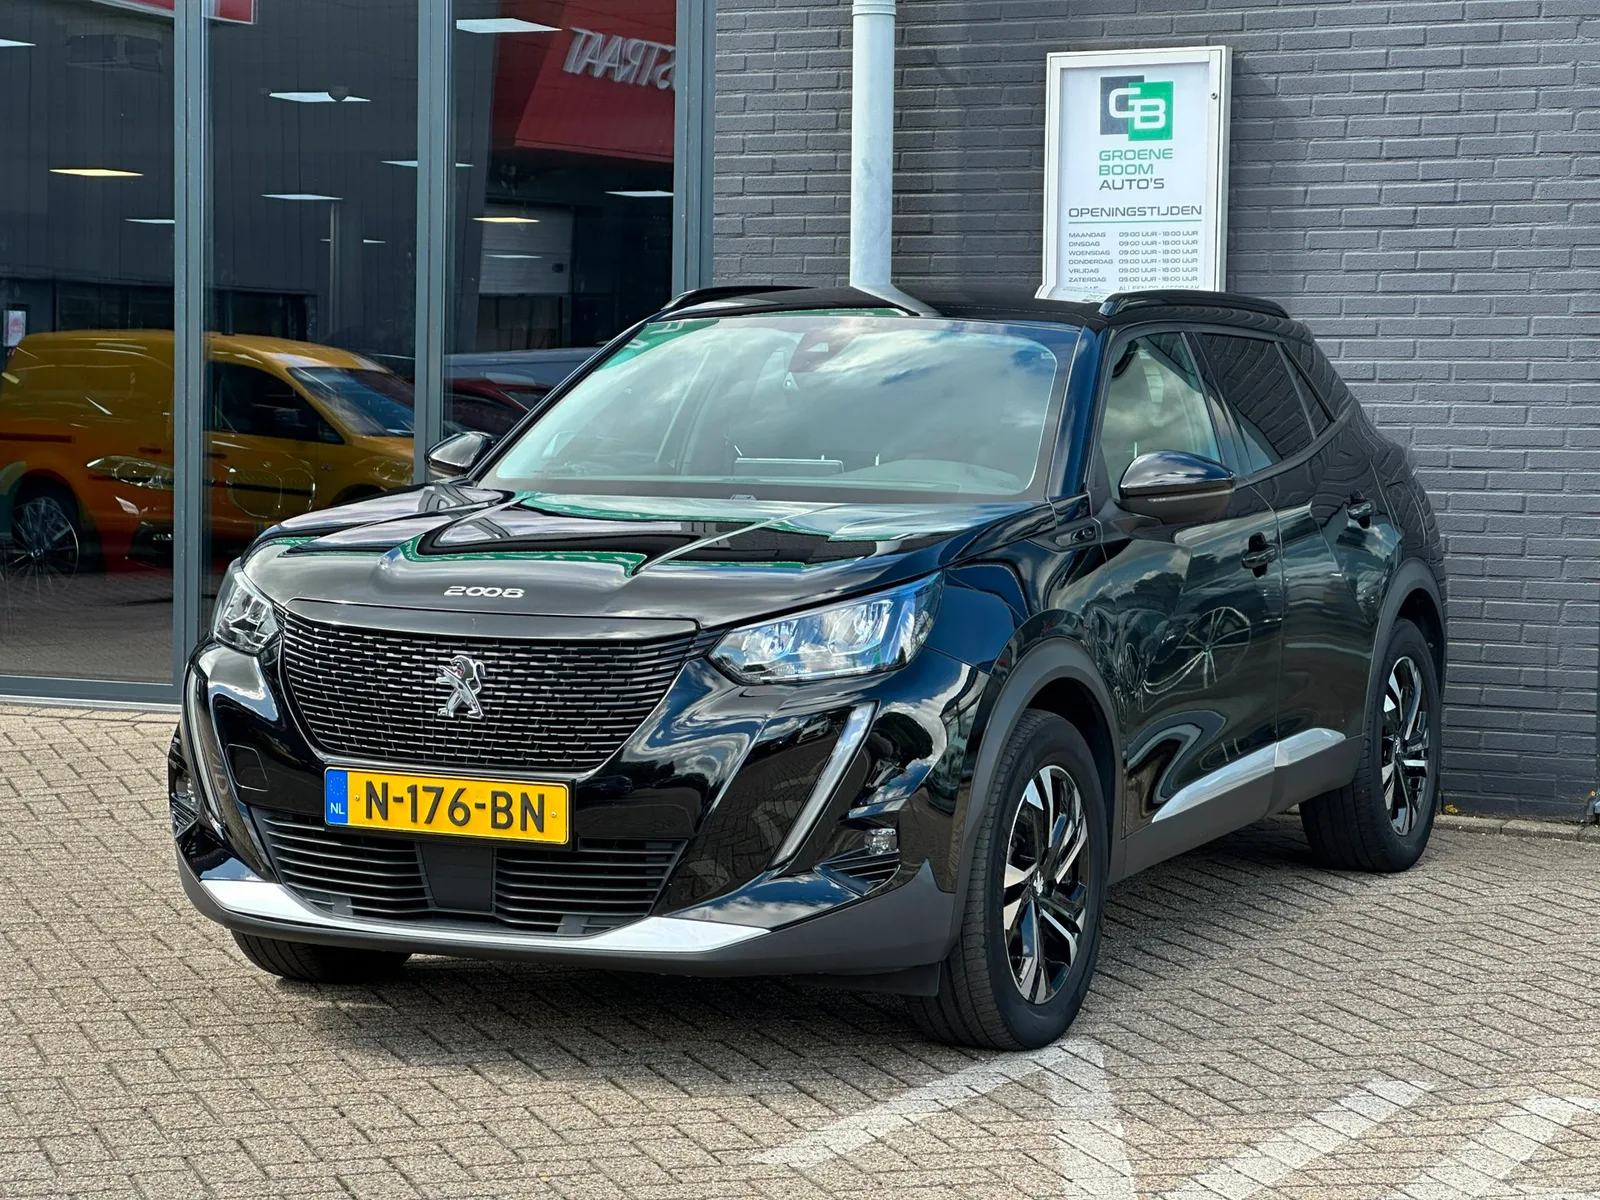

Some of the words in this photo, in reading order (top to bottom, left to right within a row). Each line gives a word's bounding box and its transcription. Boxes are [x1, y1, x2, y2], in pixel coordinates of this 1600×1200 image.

[1099, 148, 1173, 161] GROENE
[1099, 163, 1154, 176] BOOM
[1099, 178, 1165, 190] AUTO'S
[1068, 205, 1202, 218] OPENINGSTIJDEN
[443, 586, 525, 598] 2008
[330, 802, 346, 815] NL
[365, 780, 545, 833] N-176-BN
